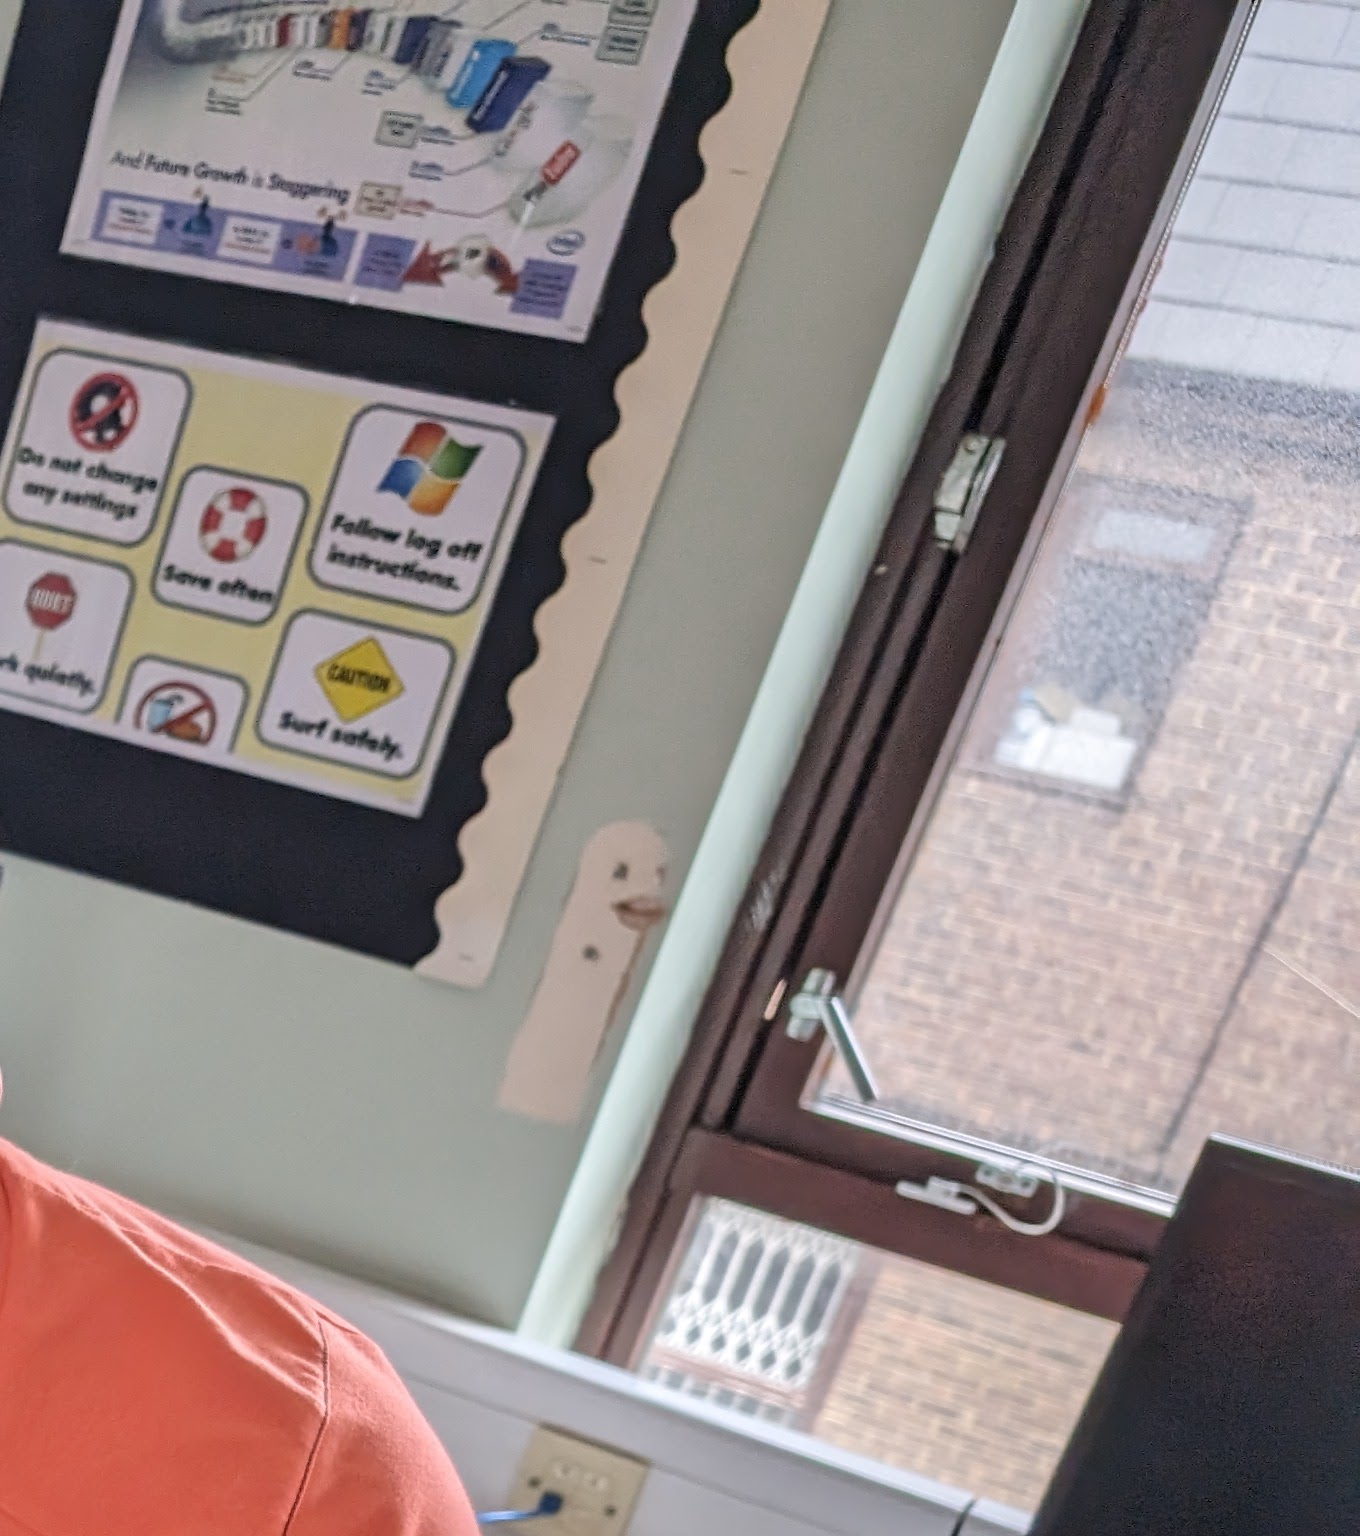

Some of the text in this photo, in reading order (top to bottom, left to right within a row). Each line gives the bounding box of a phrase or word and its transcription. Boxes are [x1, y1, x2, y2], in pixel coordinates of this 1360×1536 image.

[145, 153, 189, 177] Future
[193, 162, 248, 184] Growth
[267, 173, 351, 206] Staggering
[18, 447, 158, 494] Do not change
[23, 483, 58, 505] any
[332, 514, 482, 561] Follow log off
[164, 565, 211, 591] Save
[328, 544, 461, 591] instructions.
[327, 663, 391, 692] CAUTION
[280, 711, 328, 738] Surf
